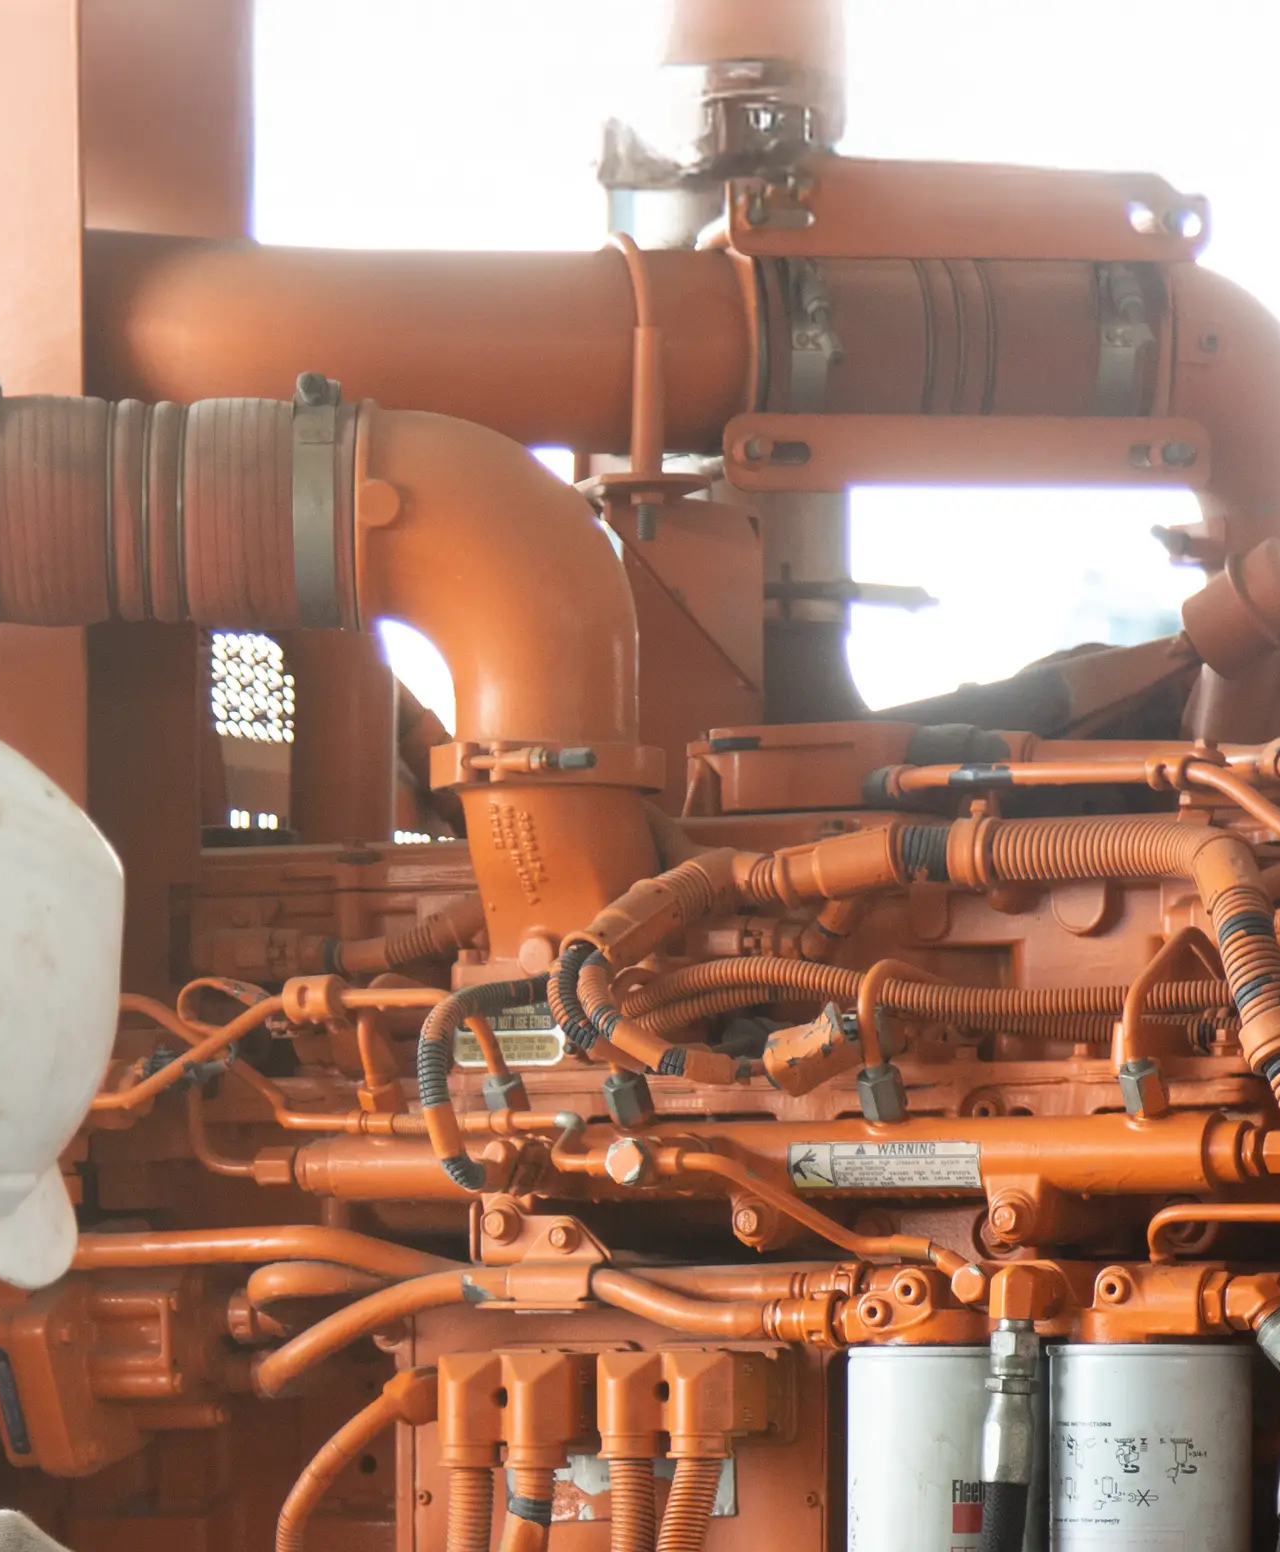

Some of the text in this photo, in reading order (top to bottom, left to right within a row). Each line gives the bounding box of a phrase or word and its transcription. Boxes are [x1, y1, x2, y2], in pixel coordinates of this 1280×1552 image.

[498, 1015, 512, 1029] NOT
[514, 1015, 528, 1028] USE
[877, 1143, 936, 1155] WARNING
[1095, 1517, 1120, 1525] properly
